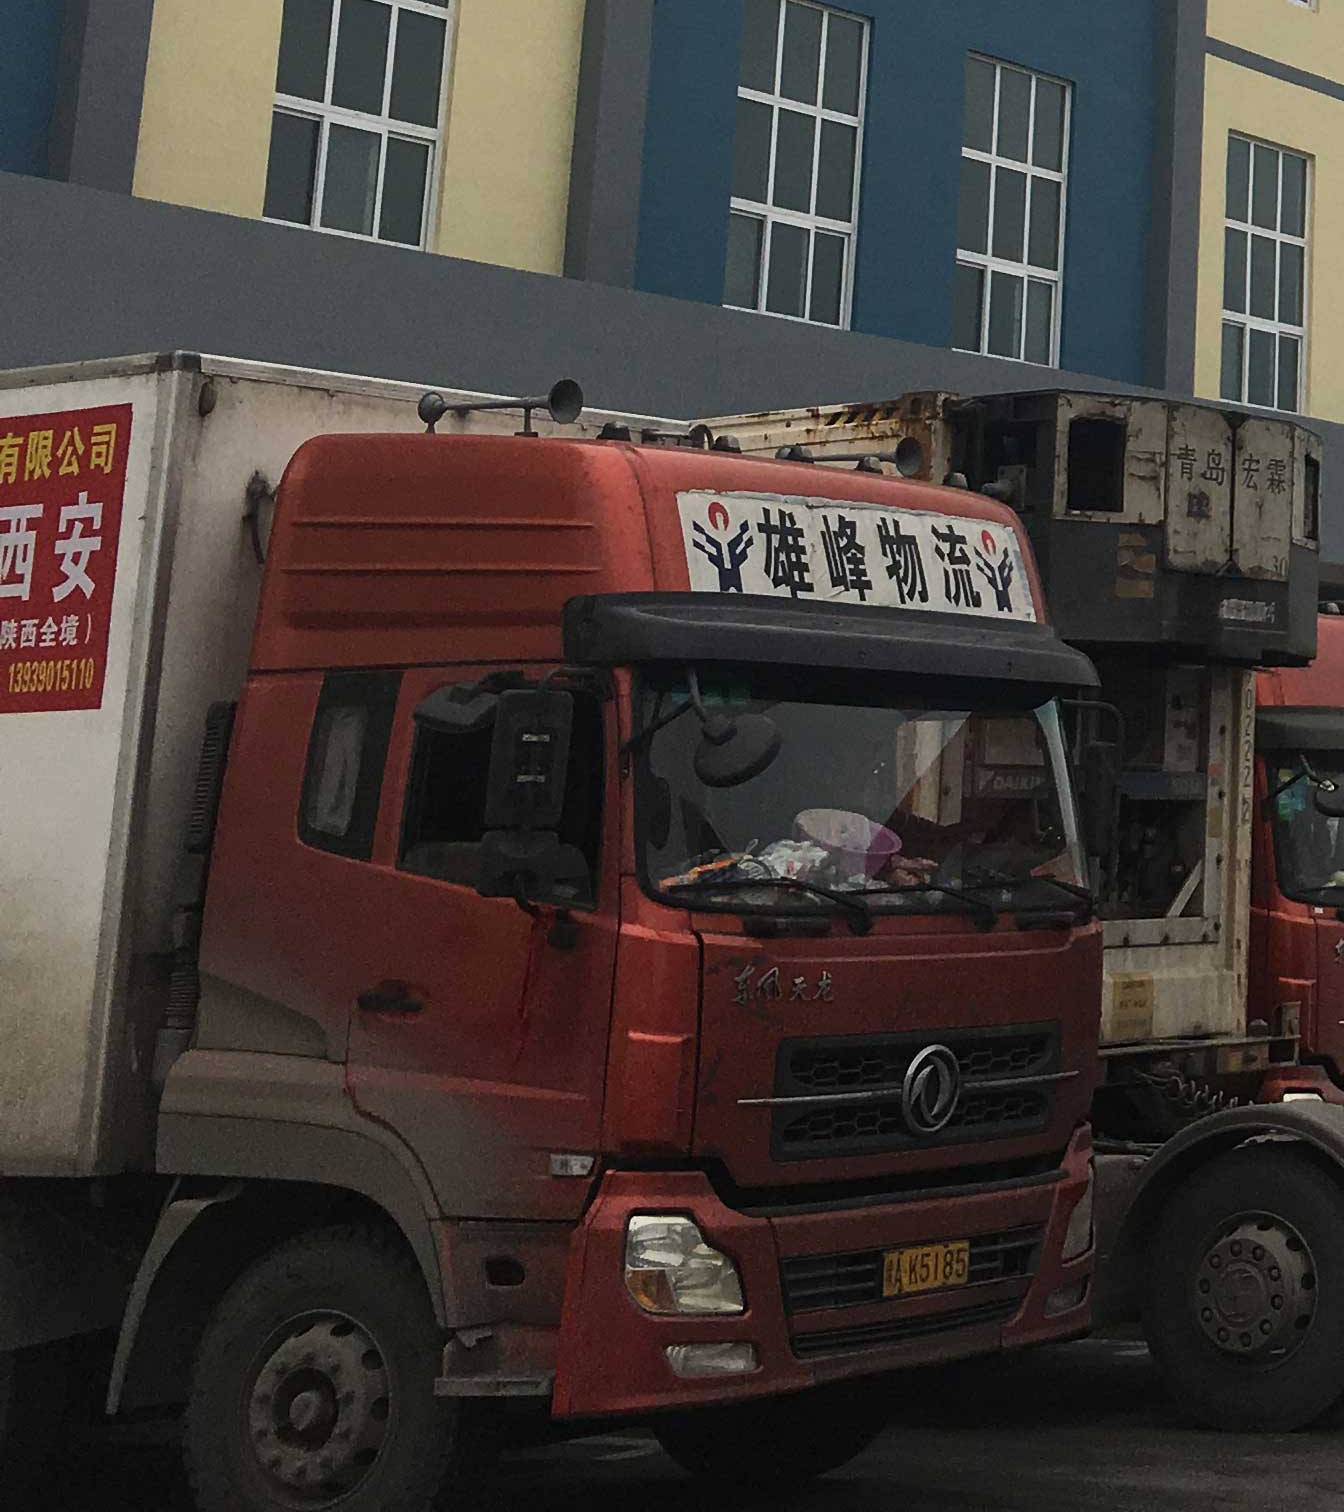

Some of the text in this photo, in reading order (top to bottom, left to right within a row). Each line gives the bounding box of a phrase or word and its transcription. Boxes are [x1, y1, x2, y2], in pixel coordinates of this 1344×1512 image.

[0, 422, 119, 485] 有限公司
[0, 490, 105, 604] 西安
[757, 505, 984, 611] 雄峰物流
[8, 657, 95, 694] 13939015110
[732, 963, 835, 1007] 东风天龙
